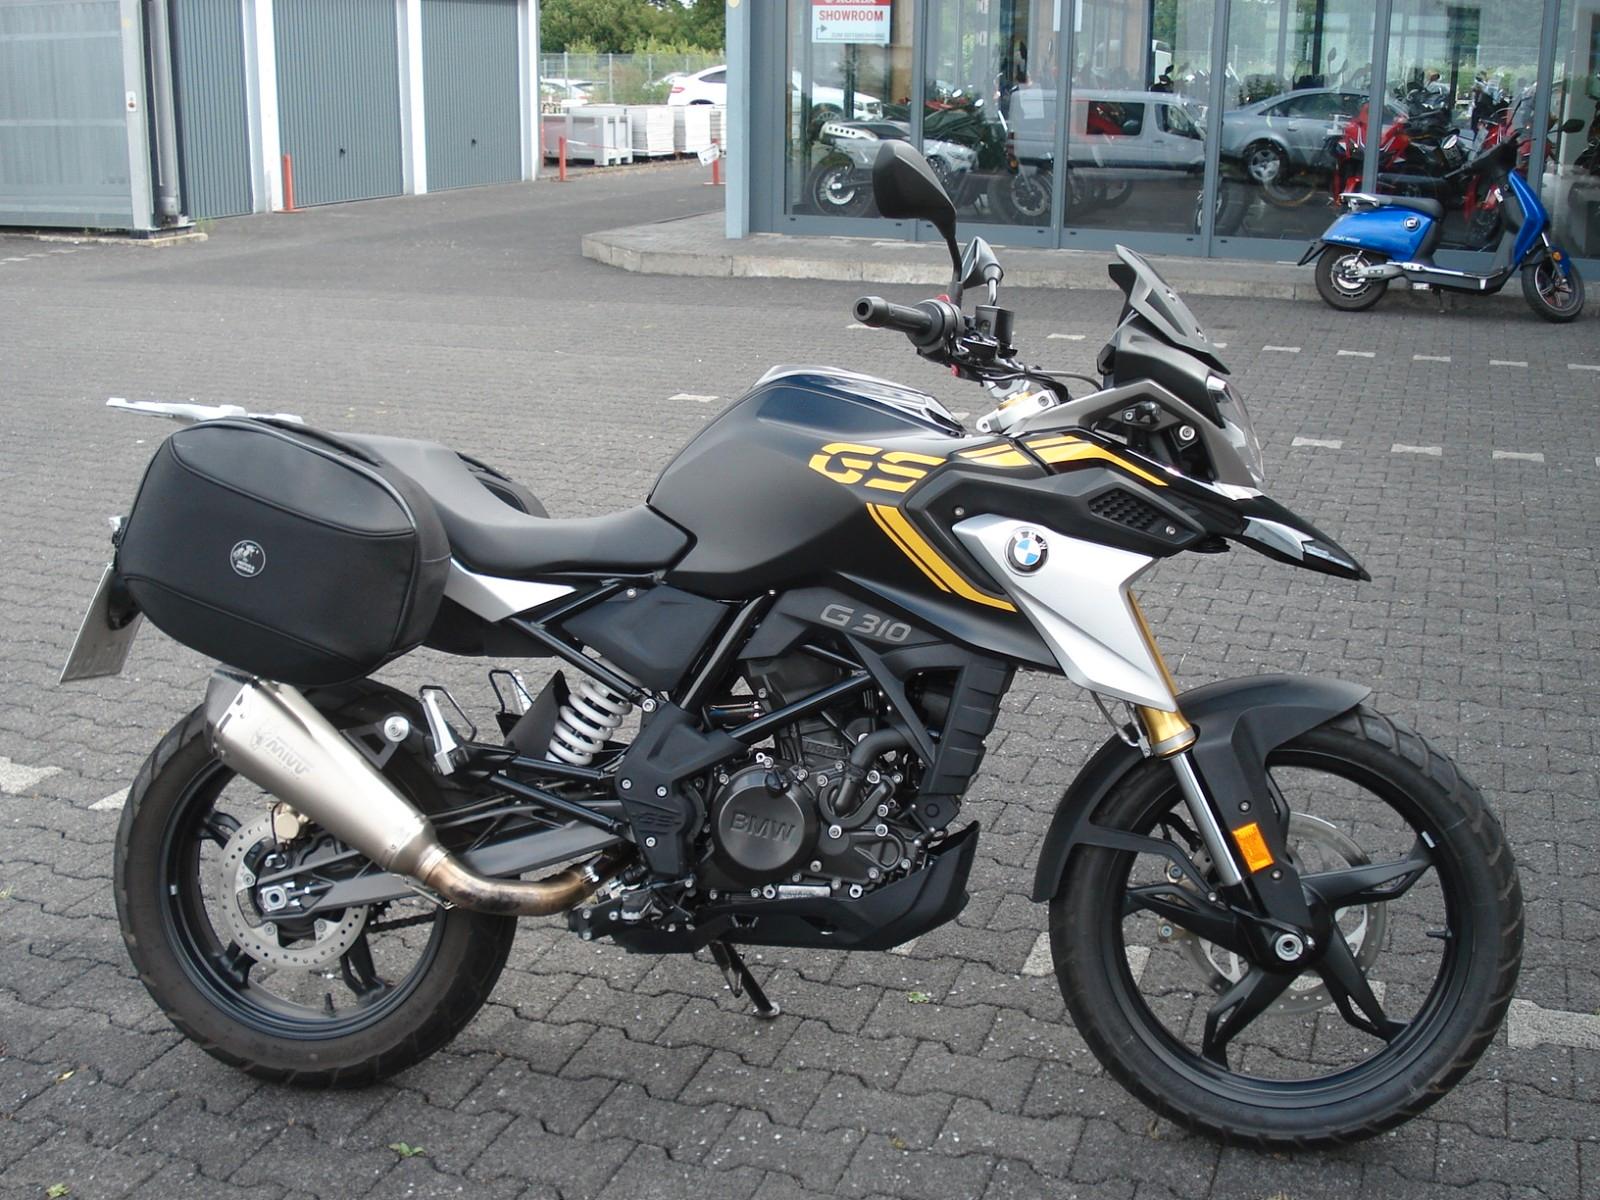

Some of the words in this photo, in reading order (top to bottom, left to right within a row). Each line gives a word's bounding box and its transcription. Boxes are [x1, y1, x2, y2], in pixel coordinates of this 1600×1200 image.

[819, 10, 883, 21] SHOWROOM
[808, 442, 947, 493] GS
[820, 604, 855, 626] G
[852, 613, 912, 642] 310
[730, 810, 796, 843] BMW
